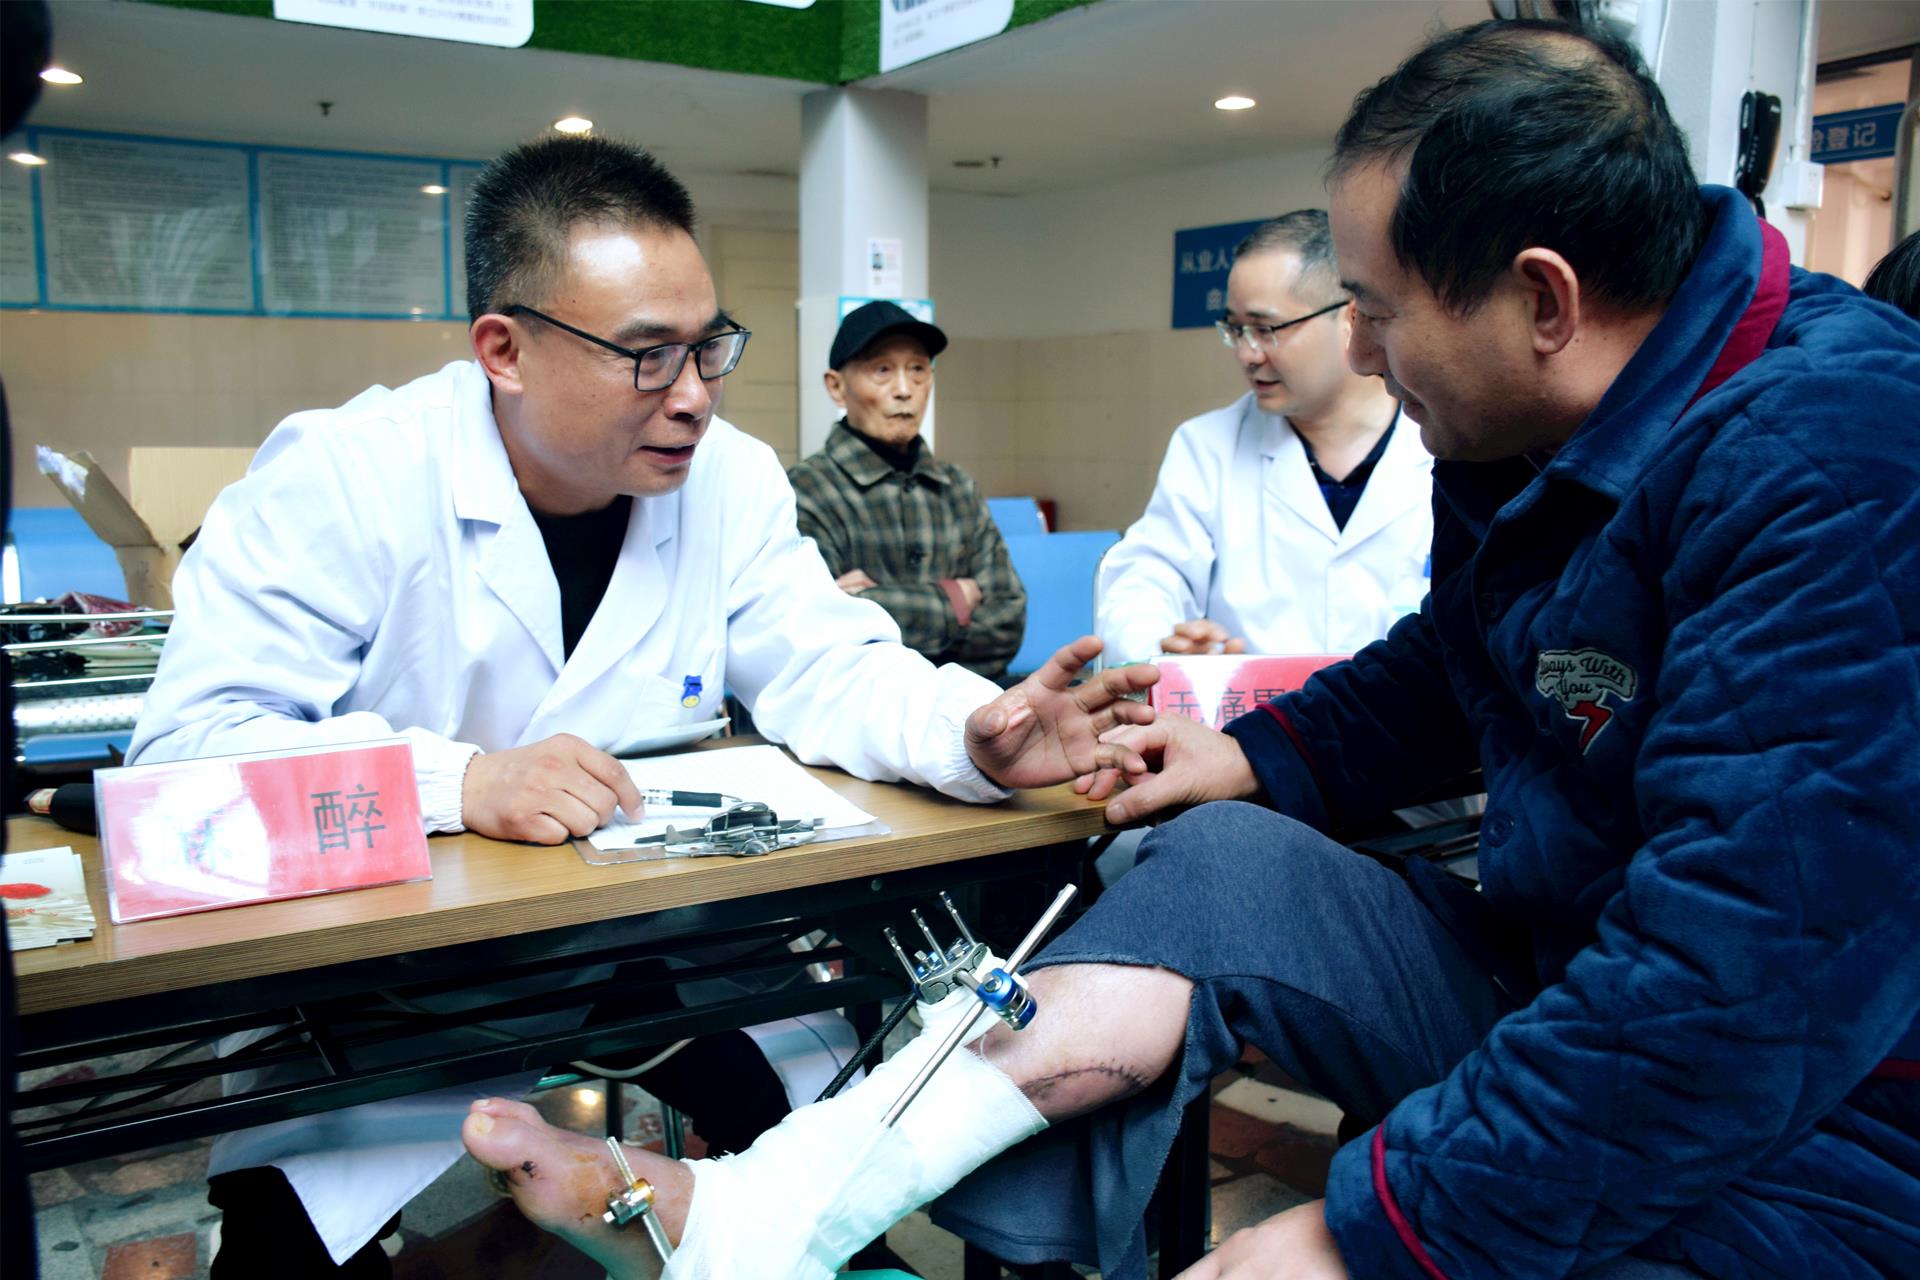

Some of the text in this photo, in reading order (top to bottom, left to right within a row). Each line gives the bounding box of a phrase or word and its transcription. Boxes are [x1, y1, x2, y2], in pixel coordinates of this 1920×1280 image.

[1181, 246, 1237, 273] 从业人
[1580, 656, 1626, 688] With
[1556, 677, 1593, 702] You
